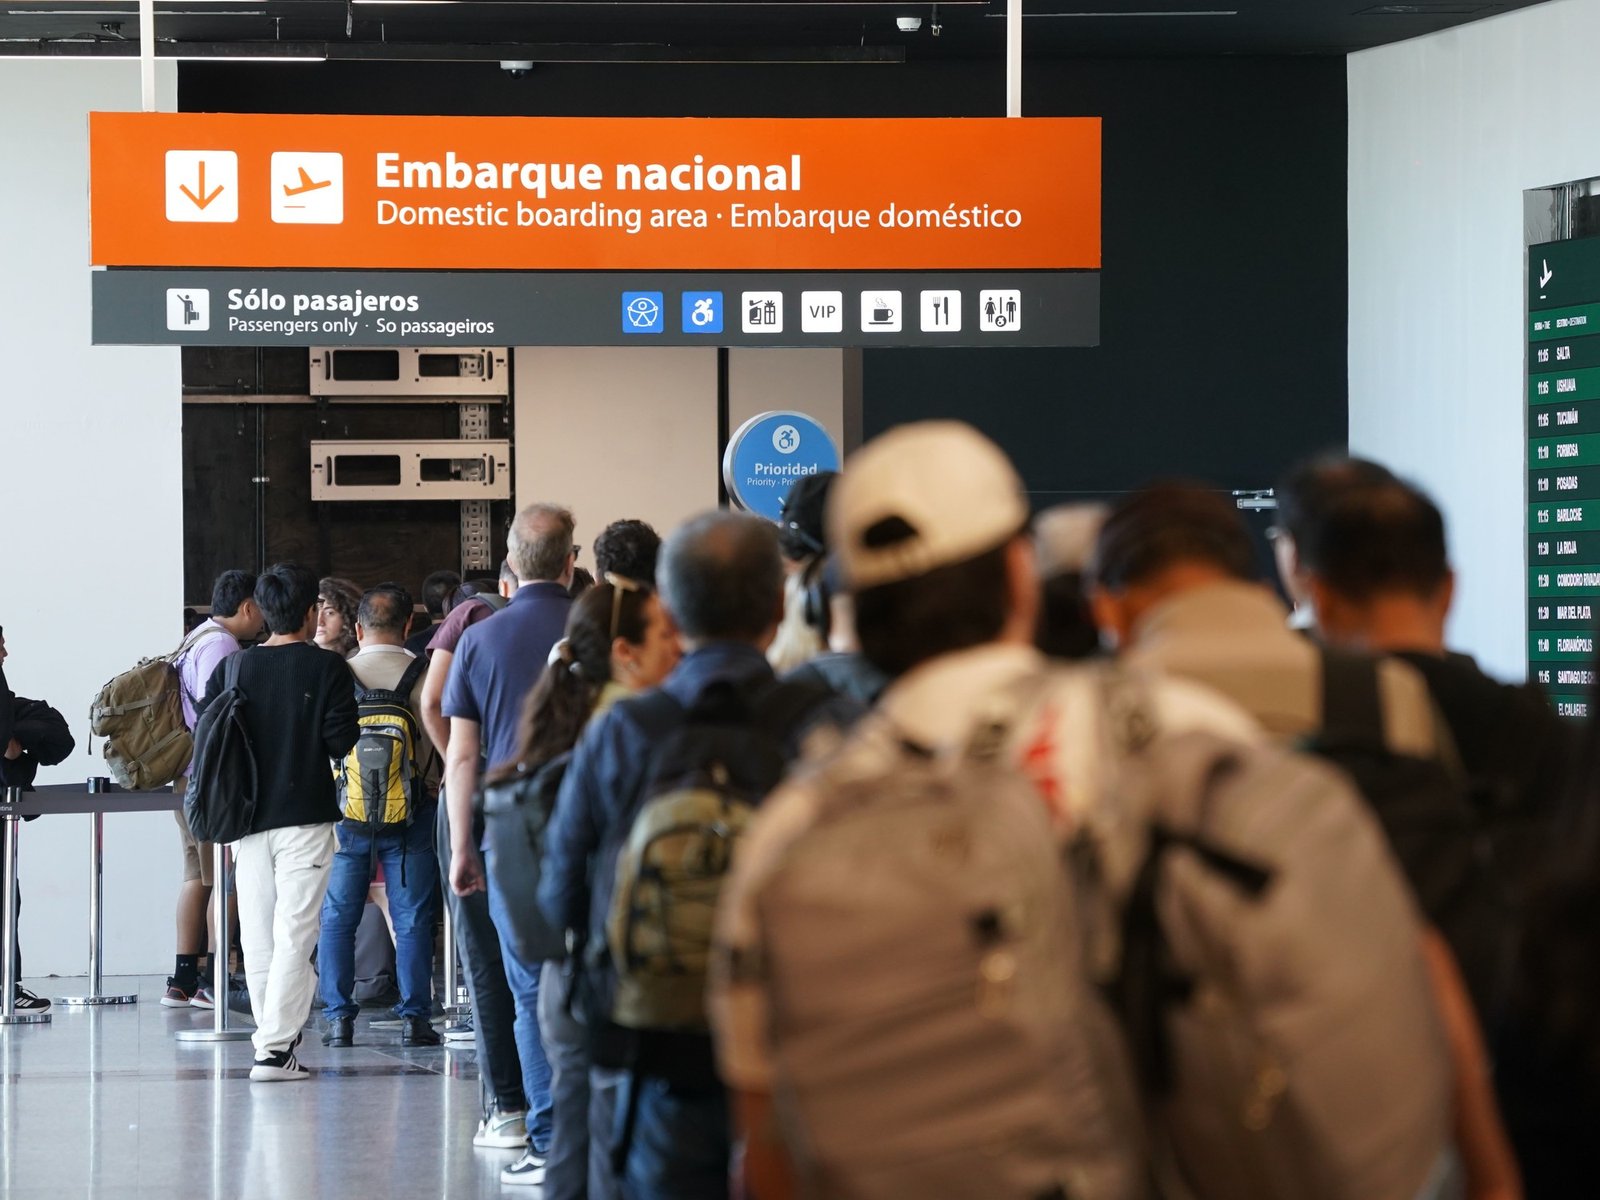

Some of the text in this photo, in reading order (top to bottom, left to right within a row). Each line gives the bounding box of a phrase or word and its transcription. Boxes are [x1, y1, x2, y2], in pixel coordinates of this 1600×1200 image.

[376, 151, 801, 199] Embarque nacional
[377, 200, 1022, 234] Domestic boarding area Embarque doméstico
[227, 287, 420, 317] Sólo pasajeros
[809, 305, 836, 318] VIP
[228, 316, 495, 337] Passengers only So passageiros
[1556, 345, 1571, 361] SALTA
[1556, 443, 1579, 458] FORMOSA
[754, 463, 818, 475] Prioridad
[746, 478, 777, 488] Priority
[1556, 476, 1578, 490] POSADAS
[1556, 508, 1583, 523] BARILOCHE
[1564, 541, 1578, 555] RIOJA
[1556, 573, 1583, 587] COMODORO
[1557, 606, 1568, 620] MAR
[1568, 606, 1577, 620] DEL
[1577, 605, 1592, 620] PLATA
[1557, 635, 1593, 652] FLORIANÓPOLIS
[1557, 670, 1581, 685] SANTIAGO
[1580, 671, 1588, 685] DE
